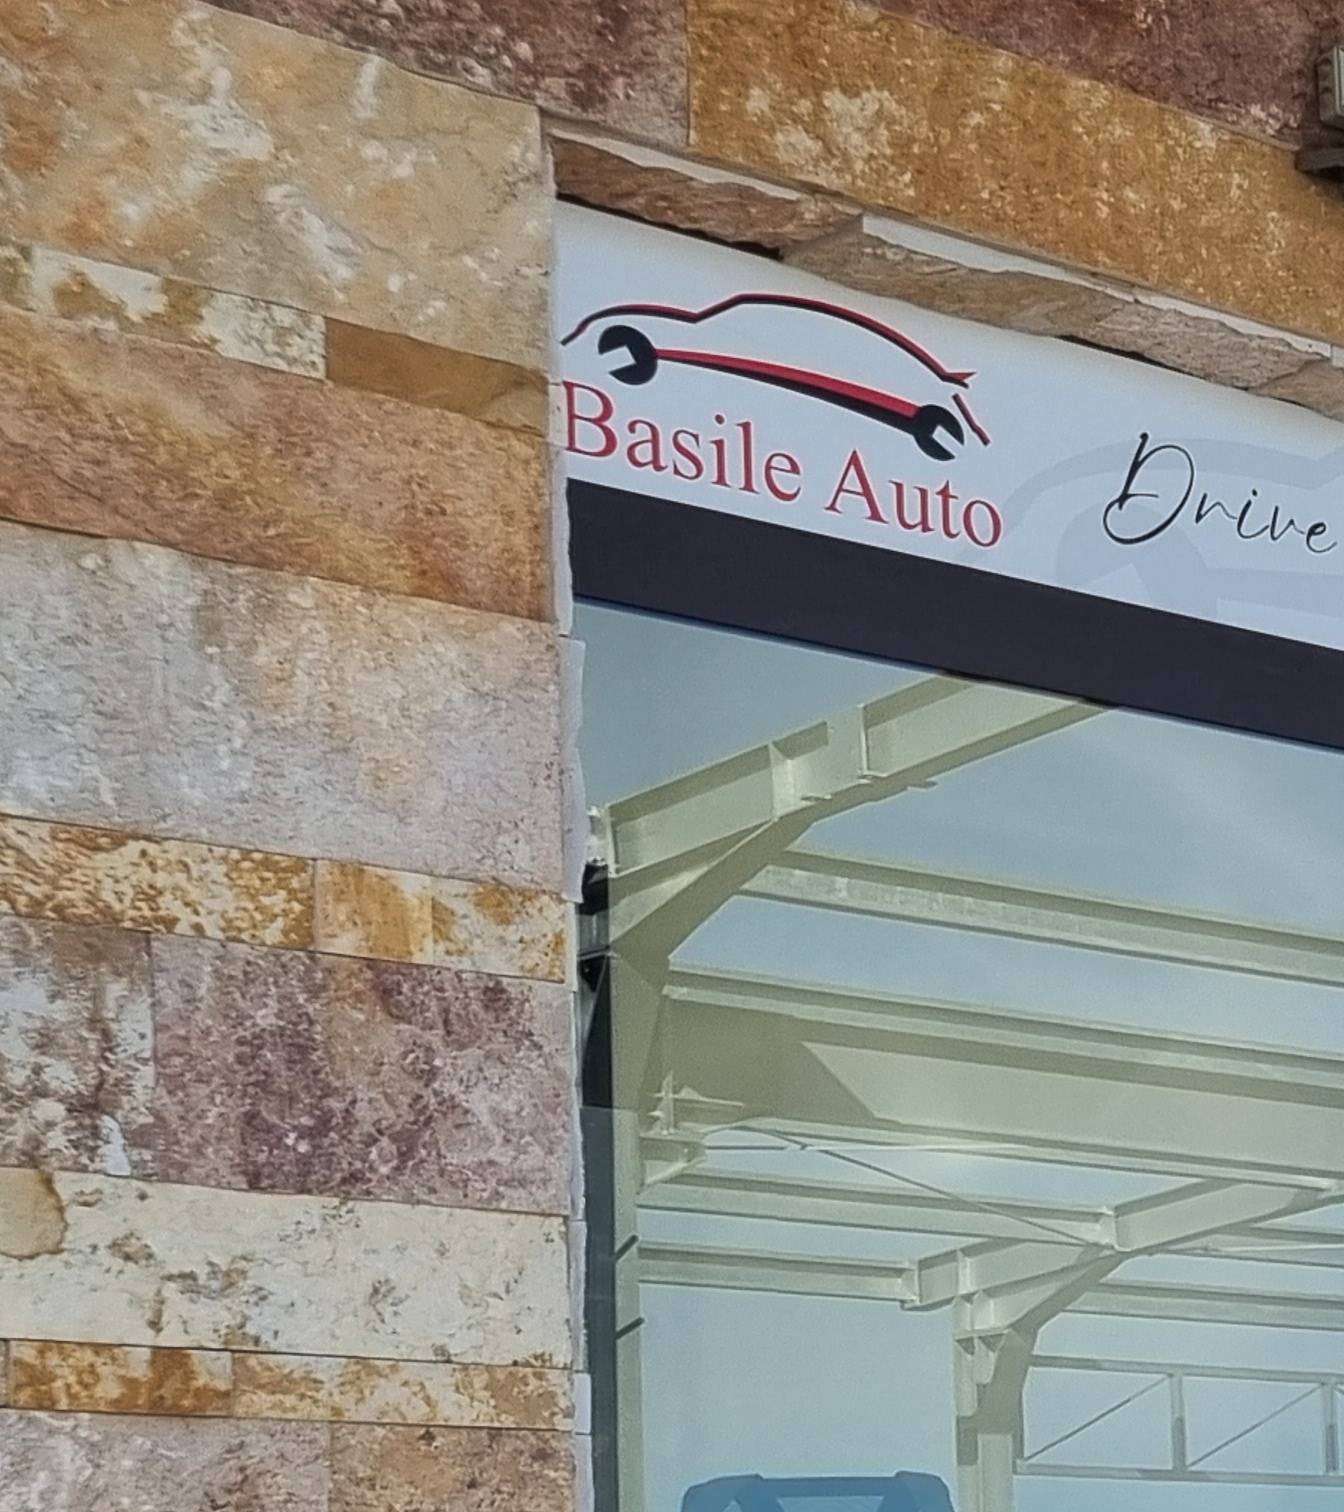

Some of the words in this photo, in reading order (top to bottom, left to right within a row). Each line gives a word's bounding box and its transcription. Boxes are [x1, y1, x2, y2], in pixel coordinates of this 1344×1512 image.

[561, 380, 801, 502] Basile
[824, 449, 1002, 547] Auto
[1103, 432, 1338, 554] Drive
